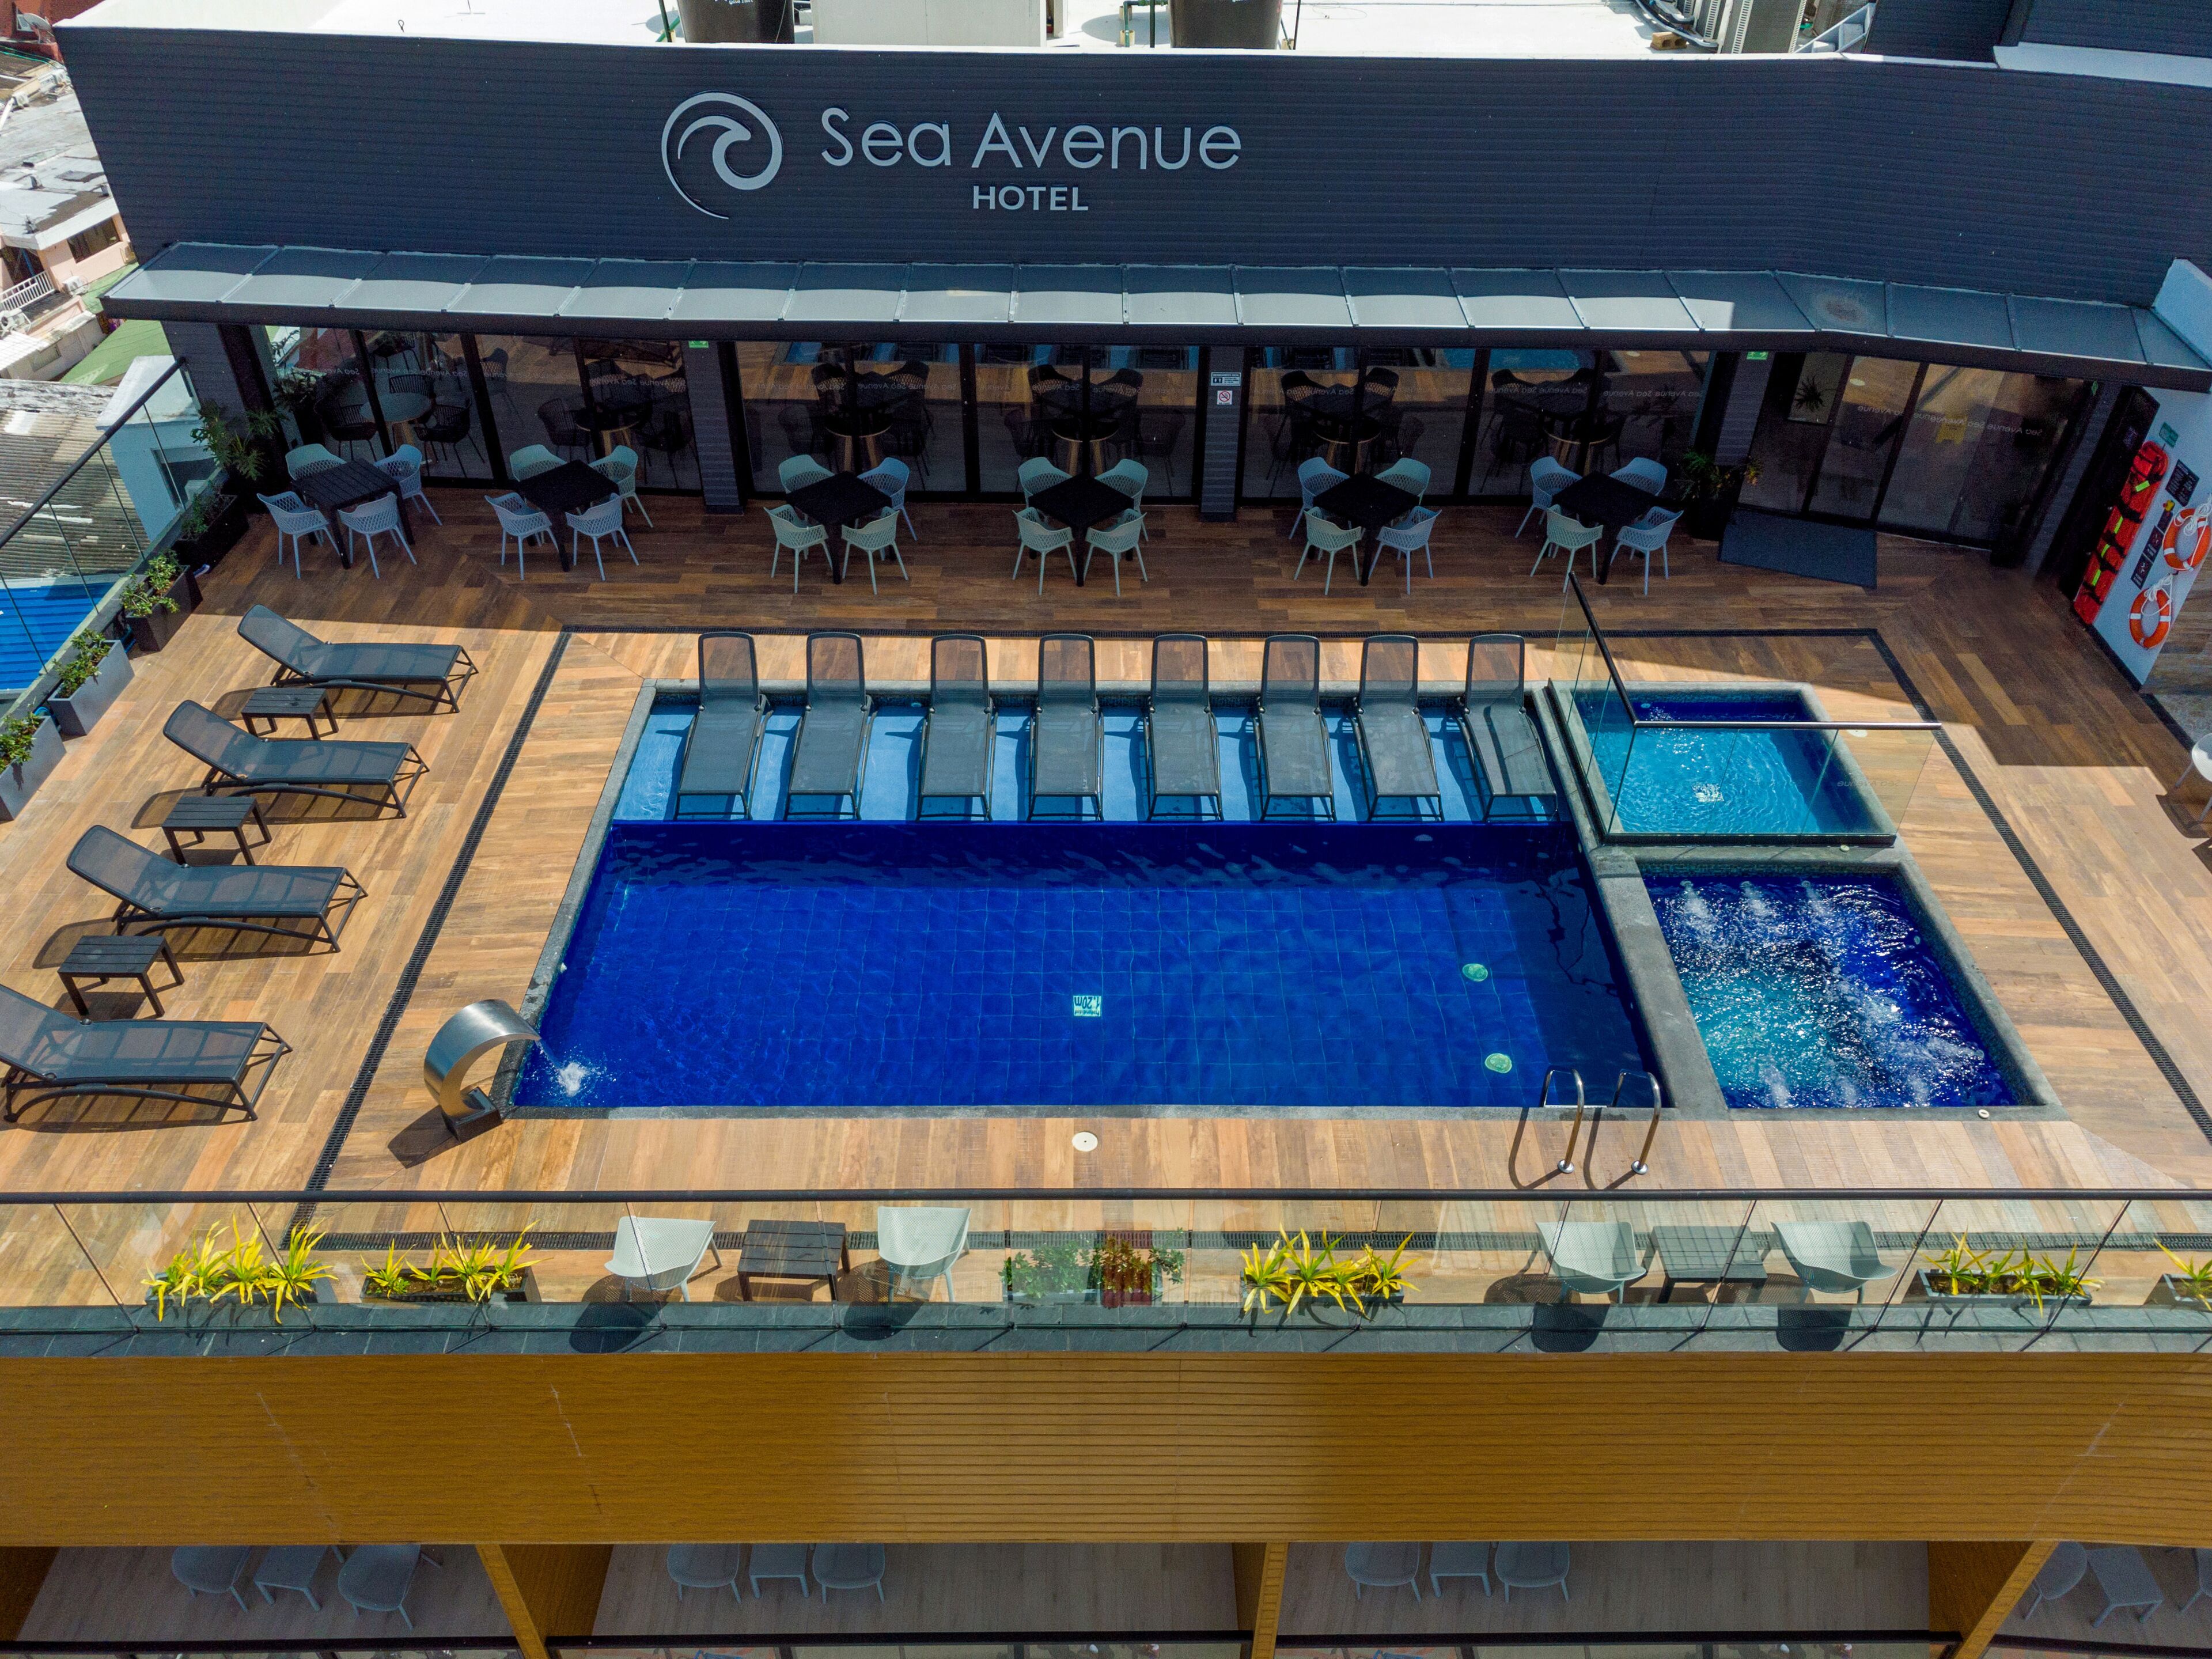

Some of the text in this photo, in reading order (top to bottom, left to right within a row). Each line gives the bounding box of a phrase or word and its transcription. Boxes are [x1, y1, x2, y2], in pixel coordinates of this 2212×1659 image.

[821, 107, 1241, 169] Sea Avenue
[972, 185, 1089, 211] HOTEL
[1074, 997, 1100, 1009] 1.20m
